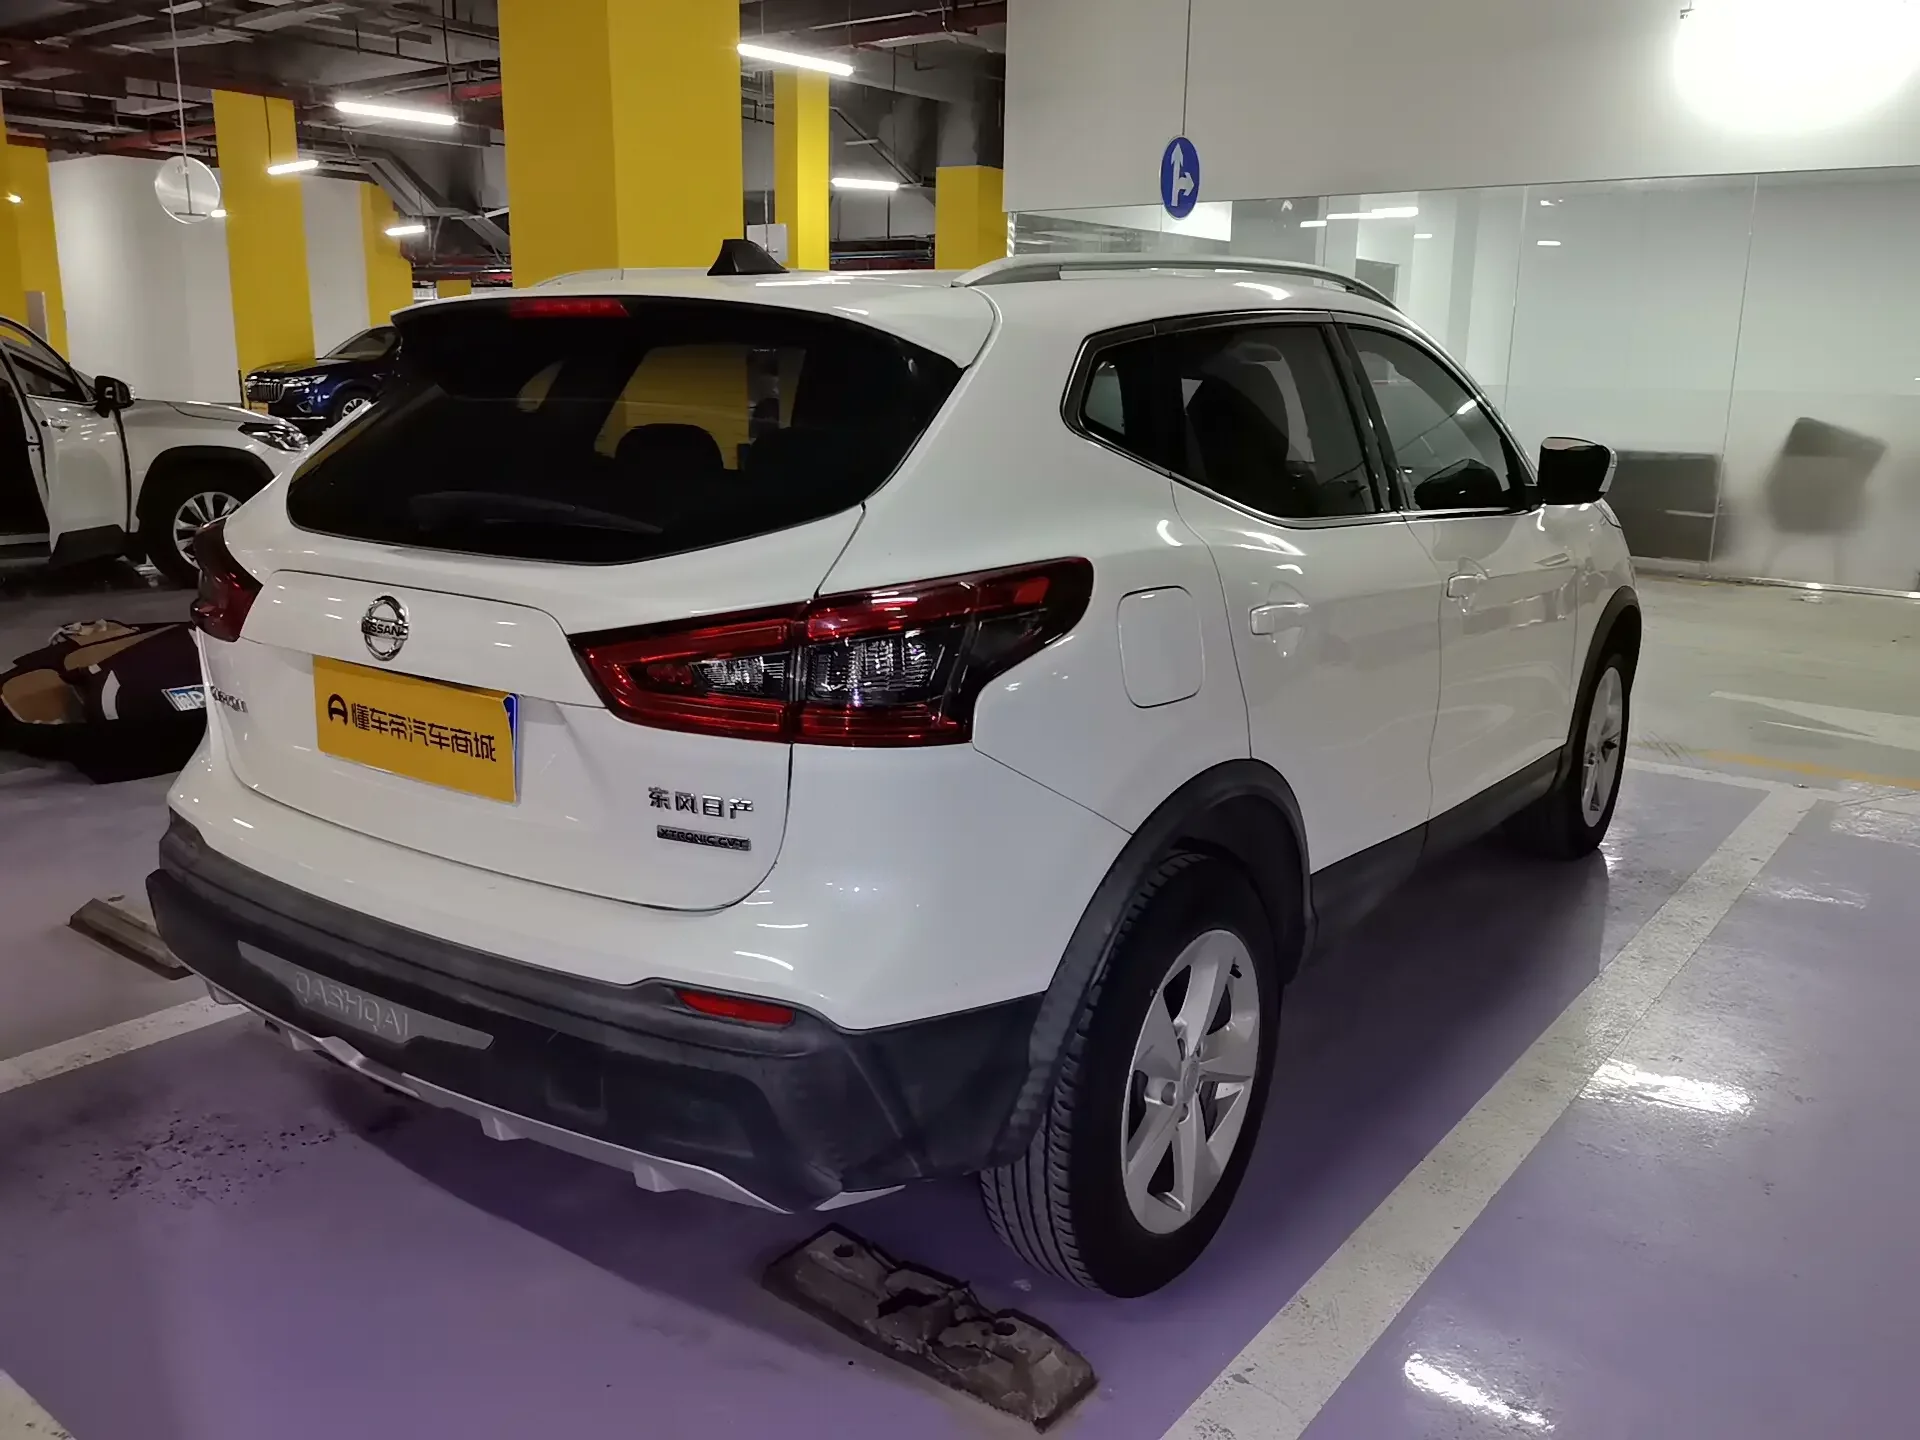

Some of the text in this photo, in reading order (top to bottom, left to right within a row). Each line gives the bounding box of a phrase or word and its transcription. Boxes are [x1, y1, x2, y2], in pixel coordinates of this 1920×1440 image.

[351, 703, 497, 762] 懂车帝汽车商城
[648, 786, 753, 819] 东风日产
[659, 827, 716, 846] XTRONIC
[296, 971, 410, 1036] QASHQAI
